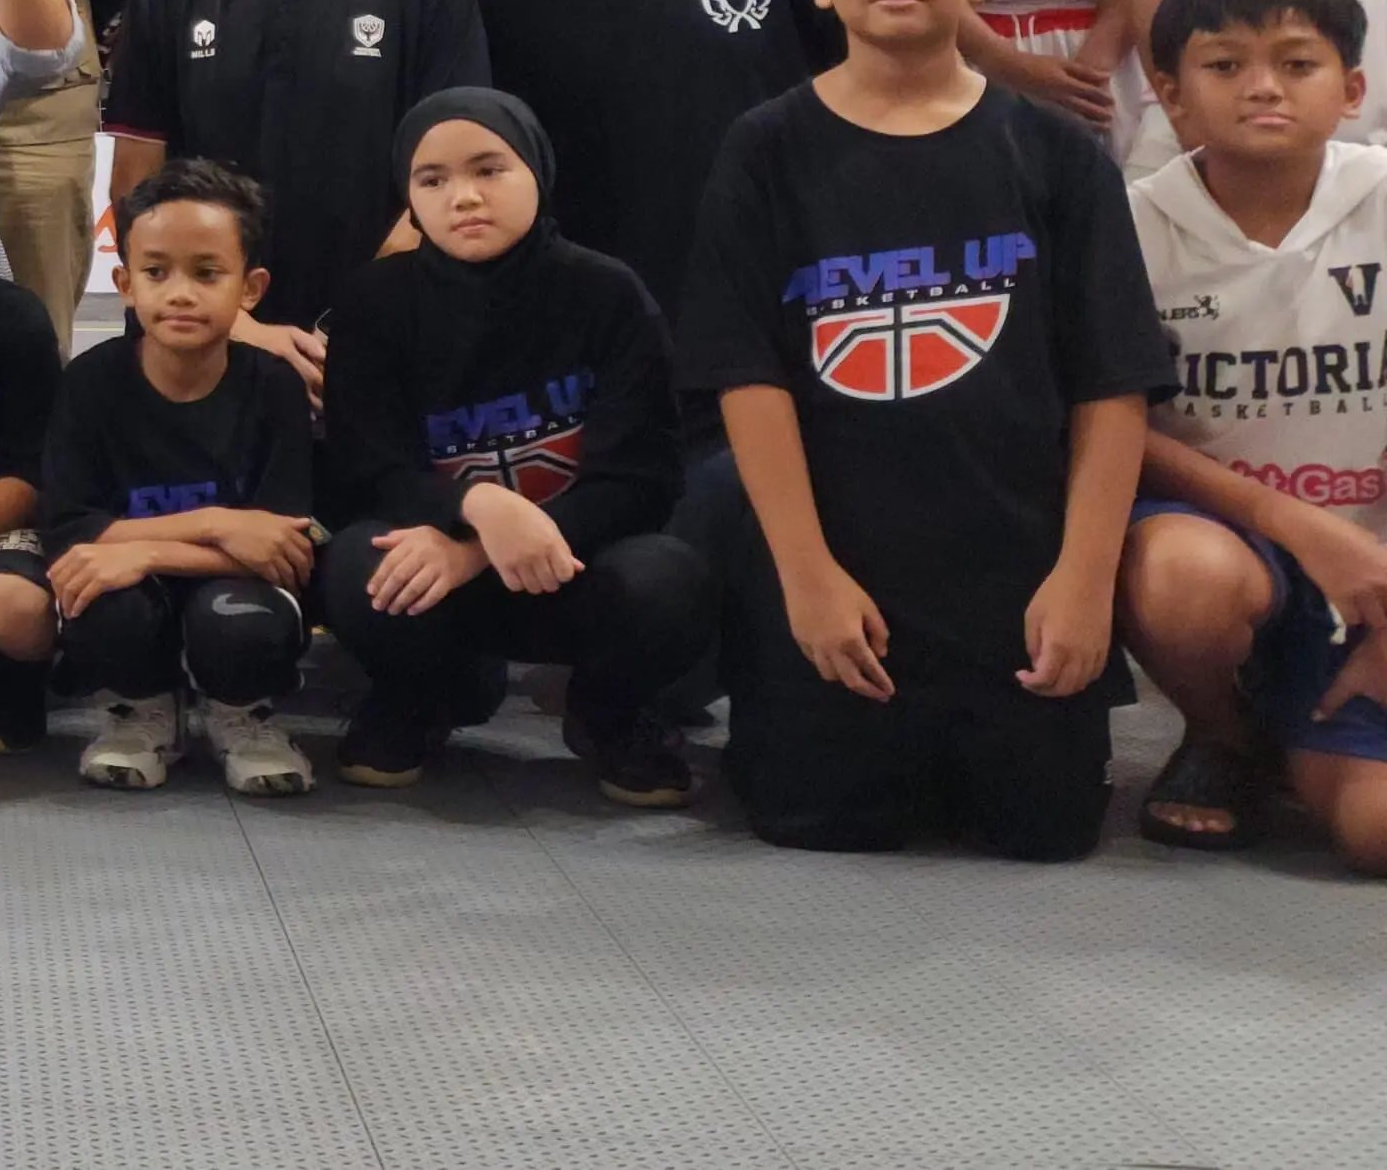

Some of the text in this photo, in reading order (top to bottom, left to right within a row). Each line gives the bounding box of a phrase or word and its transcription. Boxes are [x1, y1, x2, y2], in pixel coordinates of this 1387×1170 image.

[964, 232, 1036, 280] UP
[807, 278, 1016, 316] BSKETBALL
[1170, 332, 1387, 400] ICTORI
[1183, 393, 1387, 420] ASKETBAL
[1295, 469, 1380, 504] Gas
